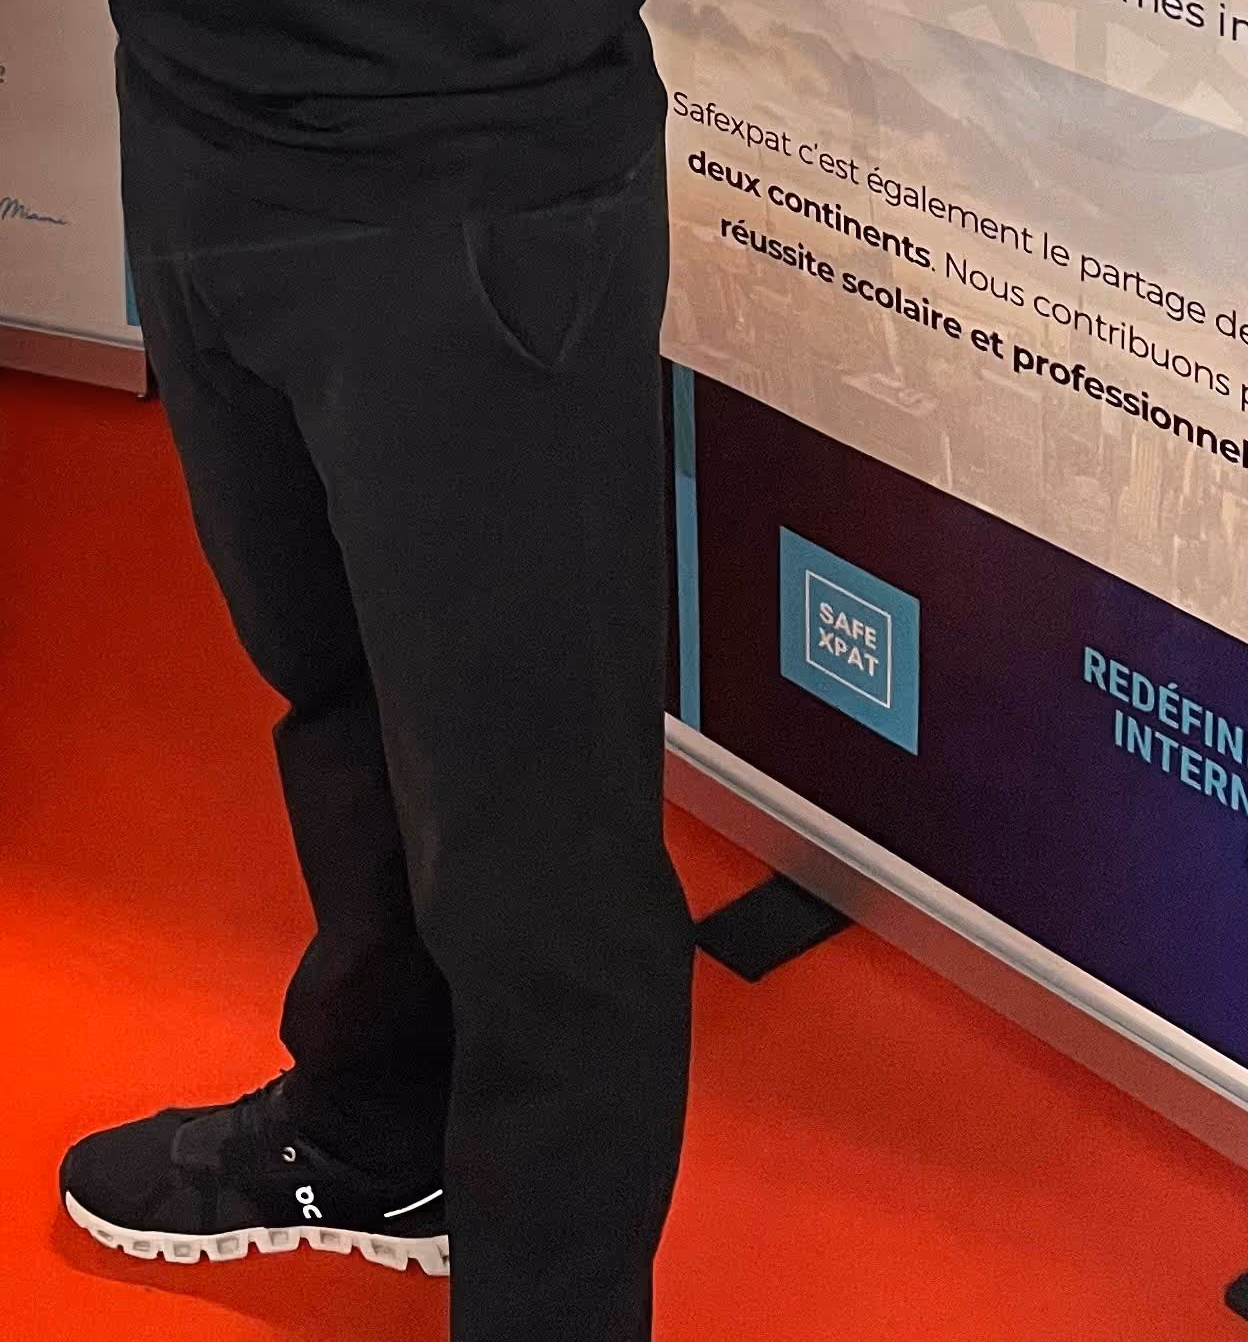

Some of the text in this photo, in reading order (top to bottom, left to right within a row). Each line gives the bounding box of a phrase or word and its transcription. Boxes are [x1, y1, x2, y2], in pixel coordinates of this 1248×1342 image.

[673, 91, 792, 157] Safexpat
[798, 142, 860, 185] c'est
[867, 167, 1033, 254] également
[1043, 232, 1070, 267] le
[1081, 254, 1206, 324] partage
[688, 150, 1230, 396] deux continents. Nous contribuons
[721, 218, 835, 284] réussite
[842, 271, 962, 339] scolaire
[970, 327, 1004, 360] et
[1013, 344, 1248, 469] professionnel
[818, 601, 878, 650] SAFE
[818, 626, 879, 677] XPAT
[1084, 645, 1244, 765] REDÉFIN
